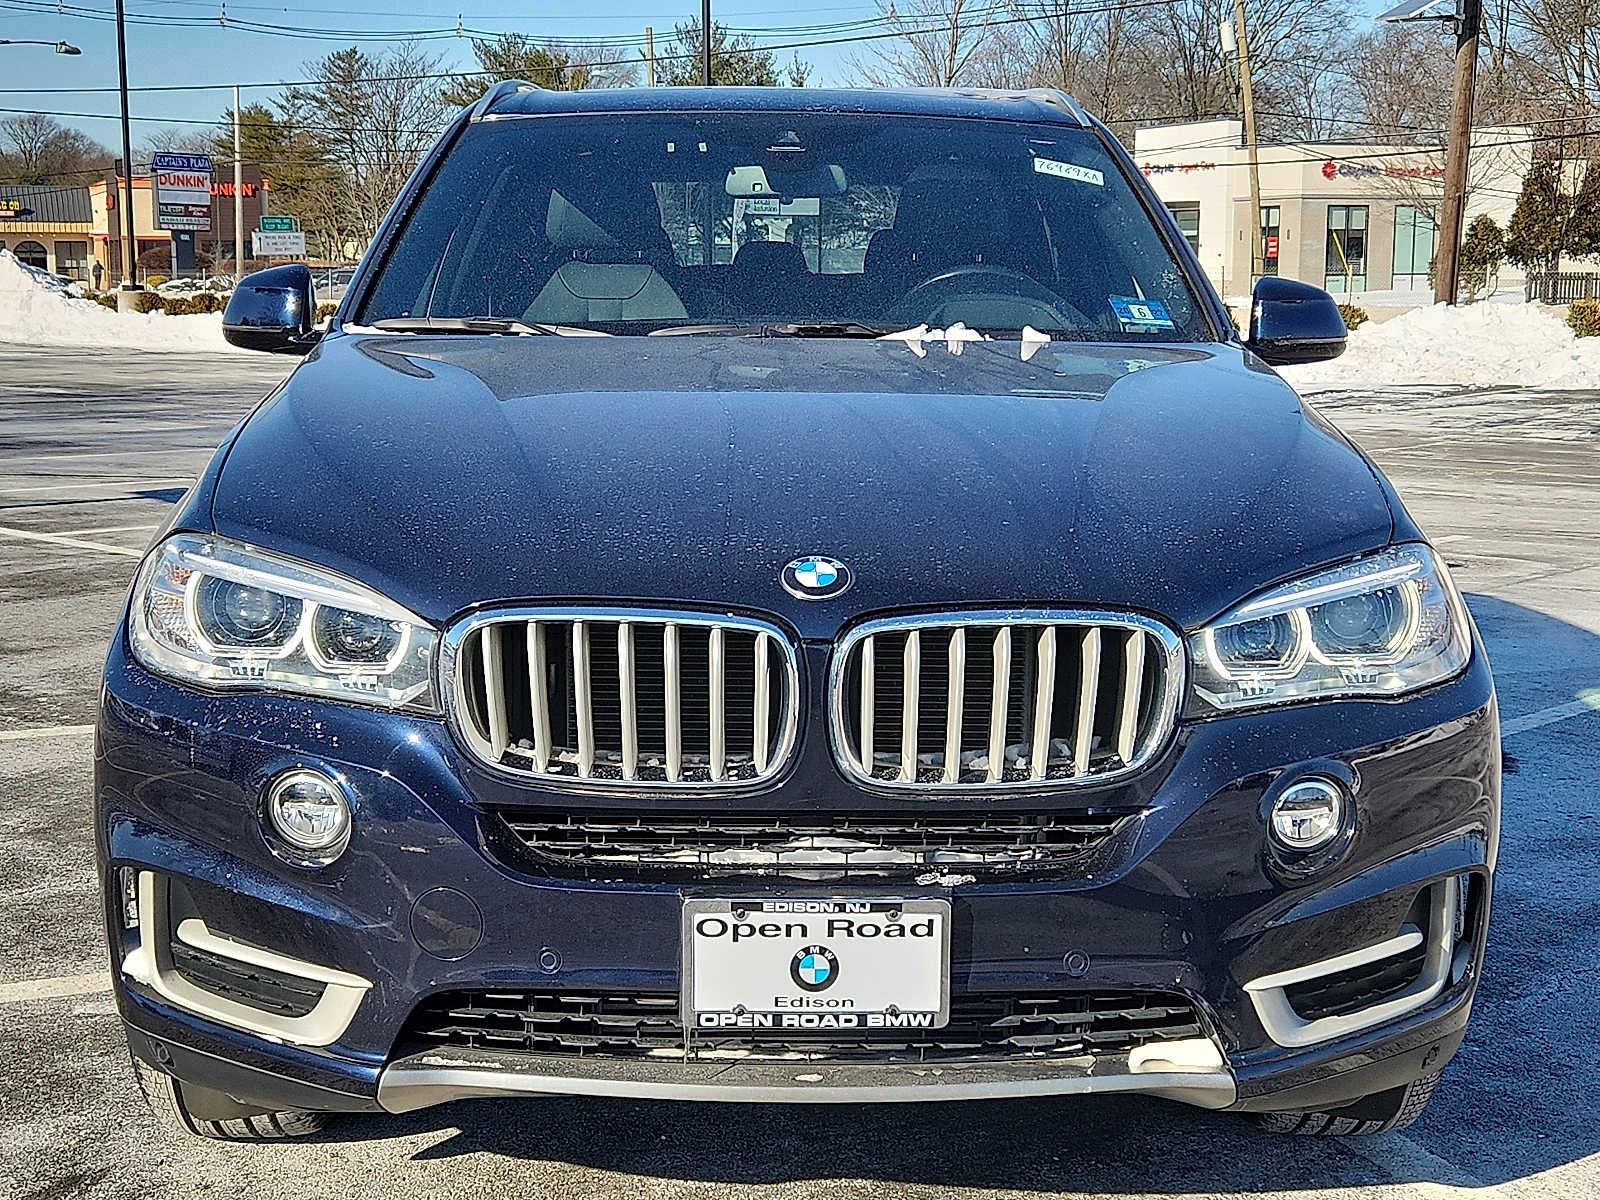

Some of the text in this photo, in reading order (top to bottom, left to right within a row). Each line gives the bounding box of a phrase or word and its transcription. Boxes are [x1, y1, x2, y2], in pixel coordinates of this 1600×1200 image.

[190, 157, 210, 169] PLAZA
[159, 173, 208, 188] DUNKIN'
[209, 182, 255, 197] UNKN'
[1137, 307, 1147, 318] 6
[845, 902, 871, 913] NJ
[695, 918, 935, 943] Open Road
[796, 945, 835, 961] BMW
[774, 996, 855, 1008] Edison
[699, 1013, 933, 1028] OPEN ROAD BMW
